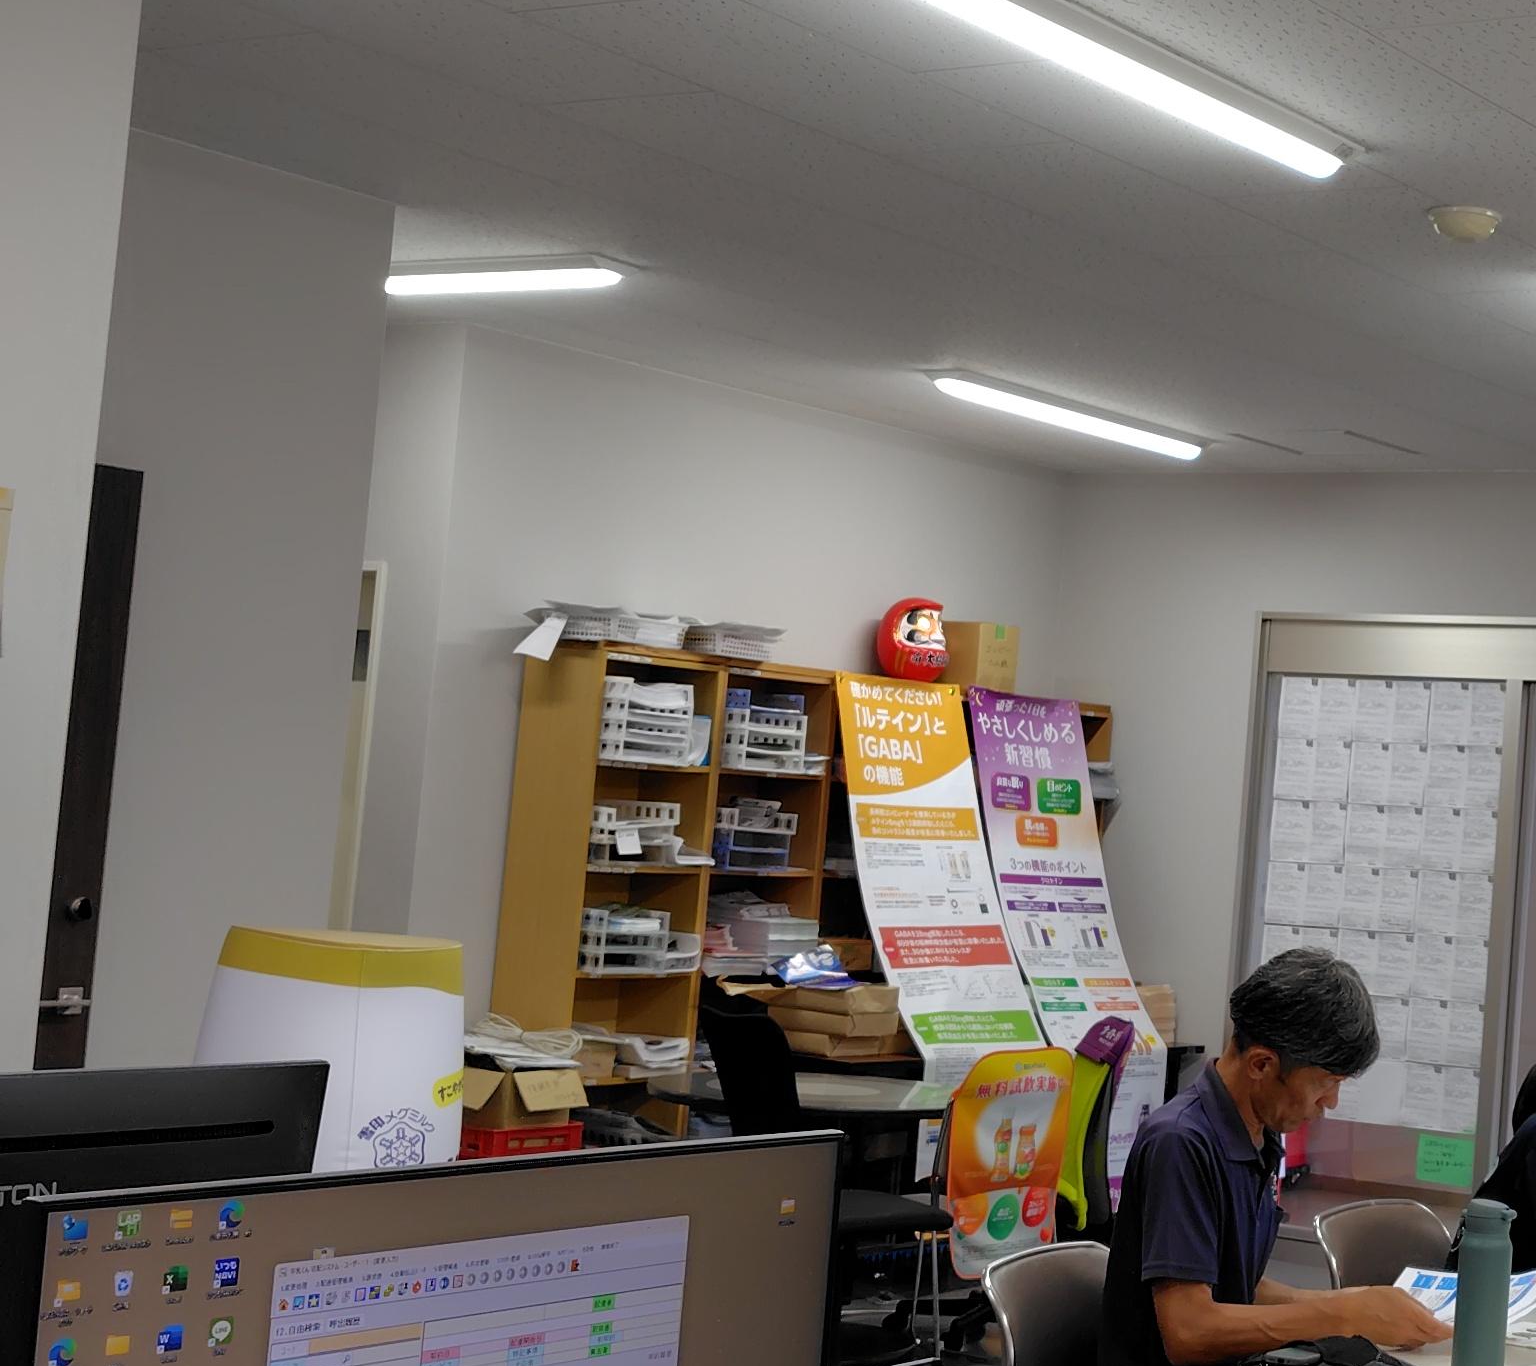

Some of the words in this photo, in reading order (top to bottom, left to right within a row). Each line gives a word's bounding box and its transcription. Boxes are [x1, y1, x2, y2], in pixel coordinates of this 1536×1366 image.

[854, 703, 946, 735] 「ルテイン」と
[858, 733, 923, 763] 「GABA」
[1004, 742, 1053, 770] 新習慣
[863, 765, 904, 786] の機能
[1009, 858, 1087, 875] 3つの機能のポイント
[357, 1107, 436, 1141] 雪印メグミルク
